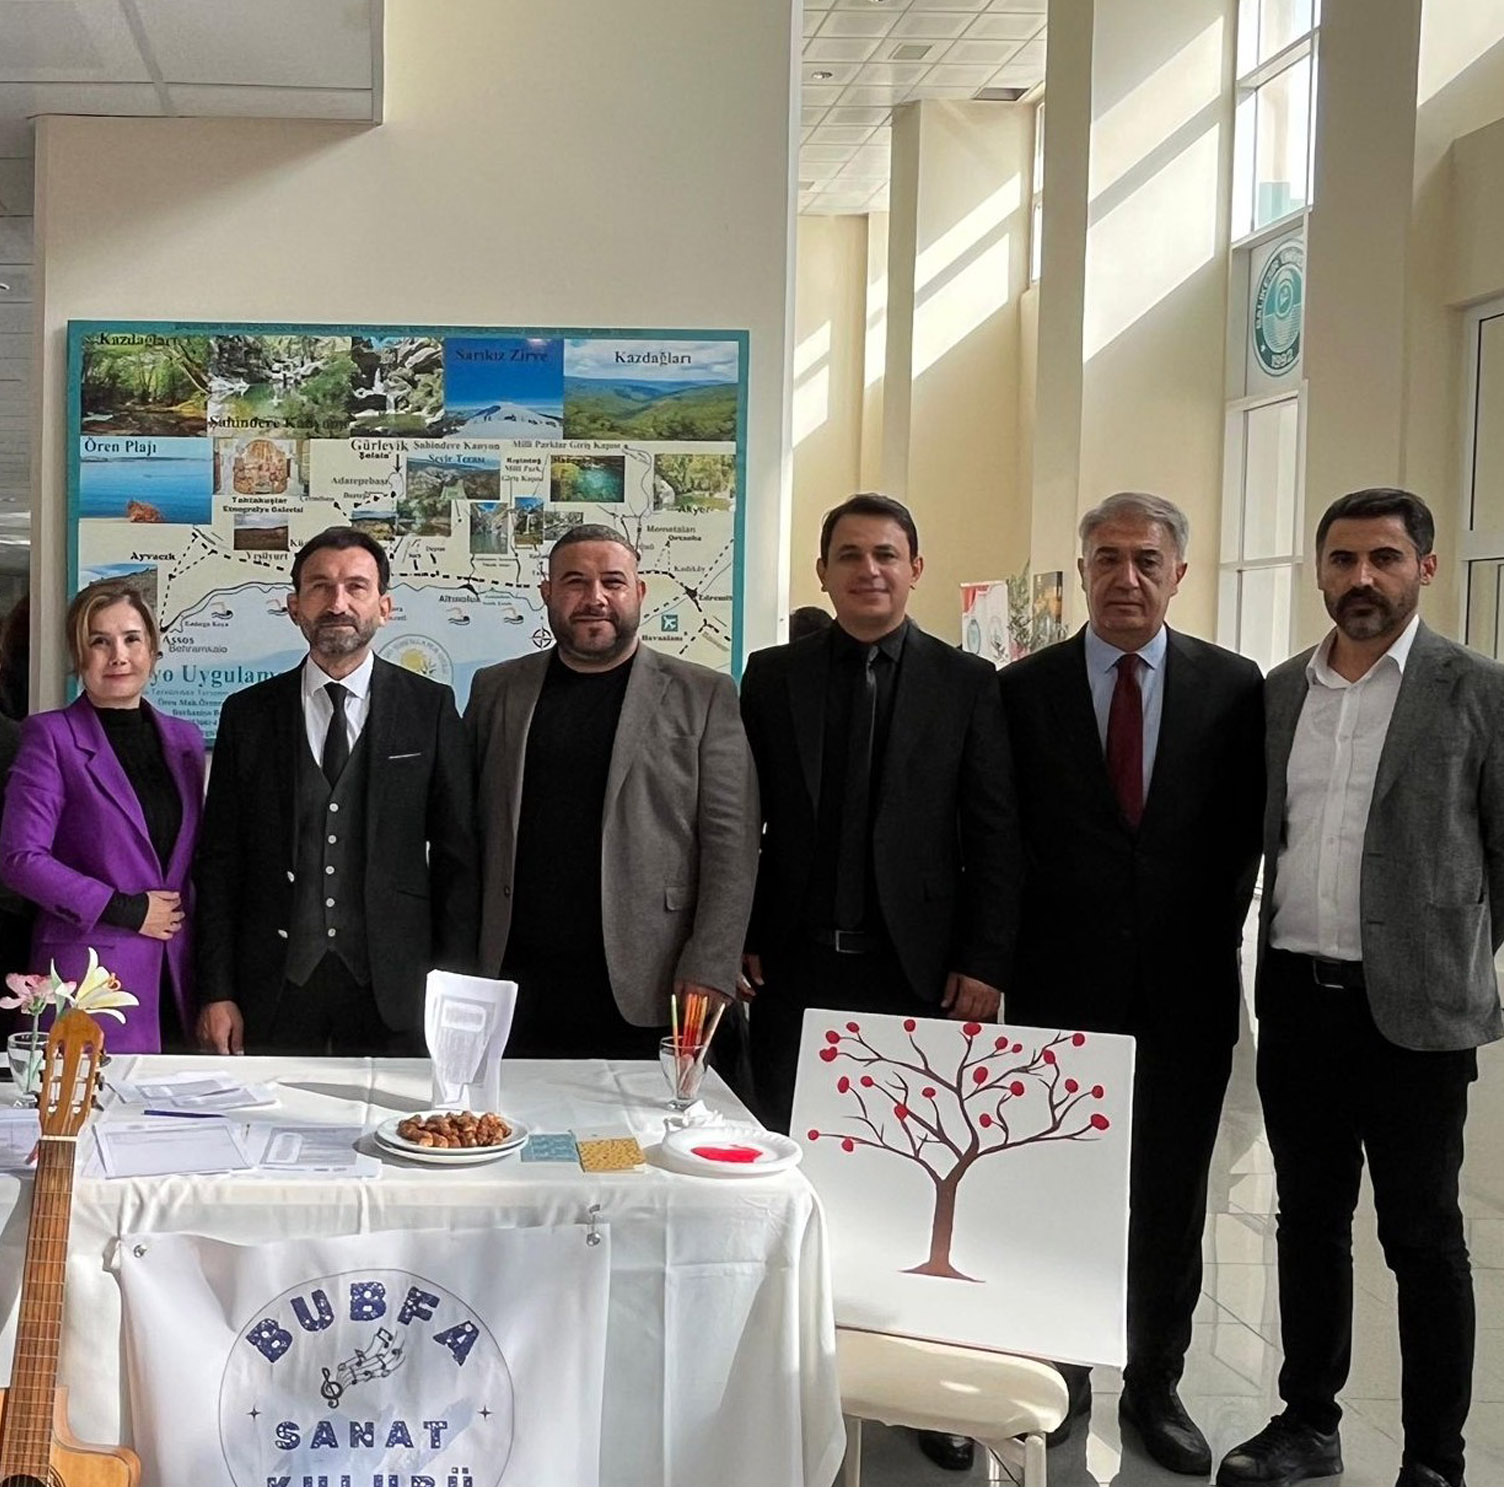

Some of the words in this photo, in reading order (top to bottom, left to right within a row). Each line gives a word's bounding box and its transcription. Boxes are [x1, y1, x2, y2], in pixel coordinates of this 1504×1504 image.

[614, 351, 692, 366] Kazdağları
[84, 436, 119, 453] Ören
[125, 441, 156, 456] Plajı
[245, 1280, 480, 1367] BUBFA
[274, 1419, 448, 1450] SANAT
